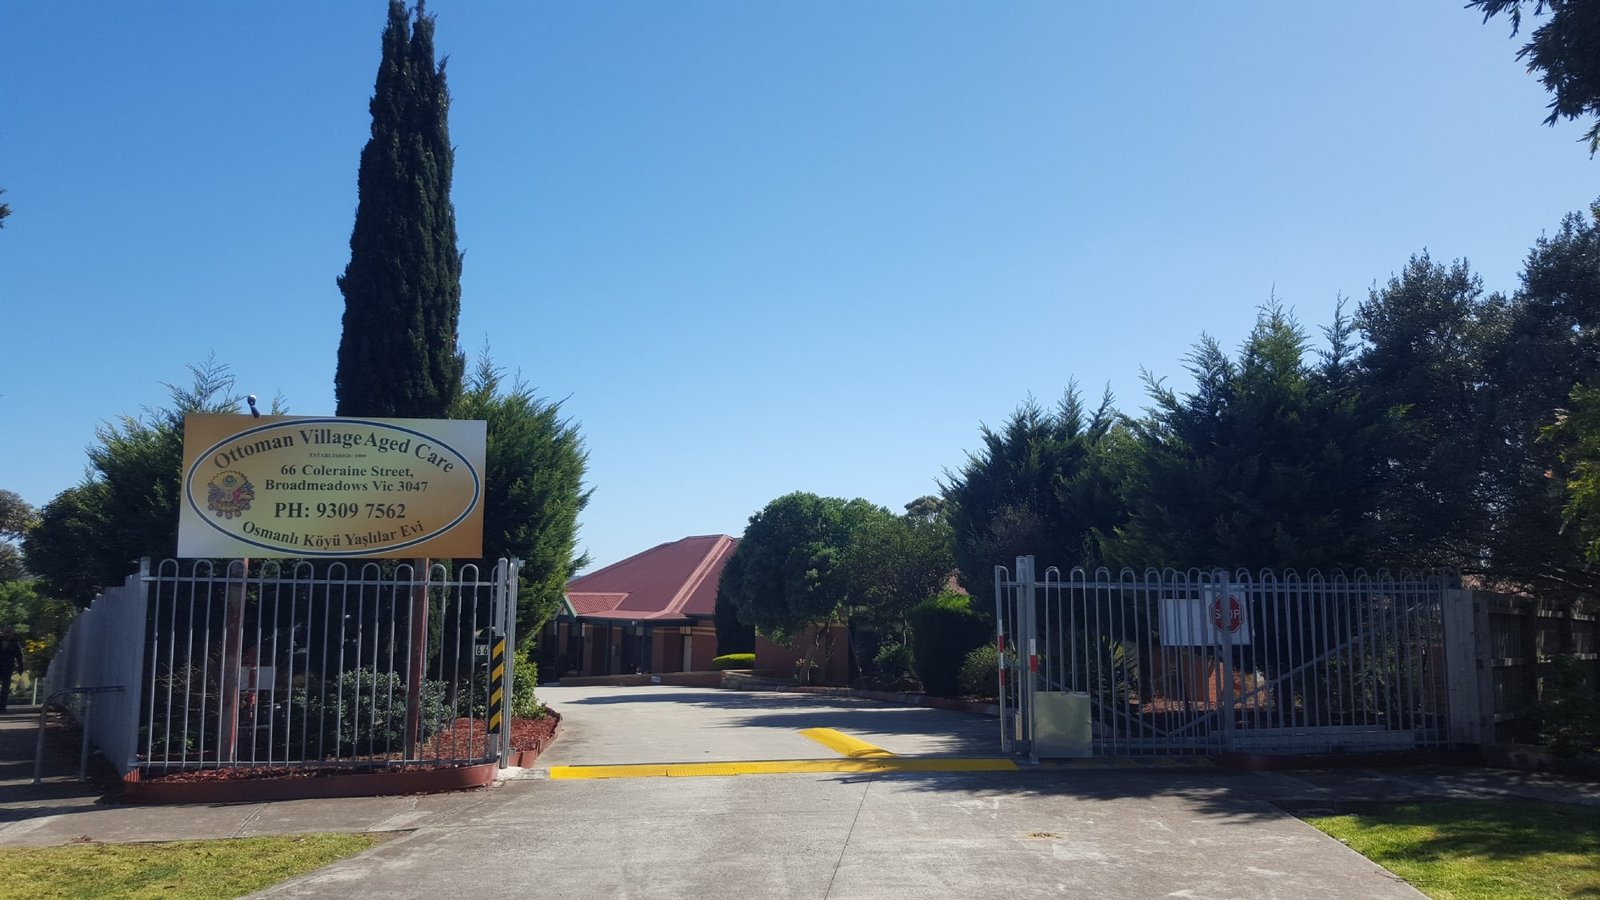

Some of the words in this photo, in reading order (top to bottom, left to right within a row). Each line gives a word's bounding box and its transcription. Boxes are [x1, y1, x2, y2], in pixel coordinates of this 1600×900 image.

[214, 435, 294, 469] Ottoman
[299, 429, 362, 449] Village
[363, 432, 411, 454] Aged
[414, 443, 454, 473] Care
[280, 465, 296, 476] 66
[302, 465, 367, 476] Coleraine
[371, 466, 414, 479] Street,
[265, 479, 368, 491] Broadmeadows
[372, 480, 394, 492] Vic
[397, 481, 428, 493] 3047
[273, 502, 310, 519] PH:
[316, 503, 358, 519] 9309
[366, 503, 406, 519] 7562
[303, 534, 340, 550] Köyü
[400, 520, 424, 537] Evi
[476, 645, 488, 655] 66
